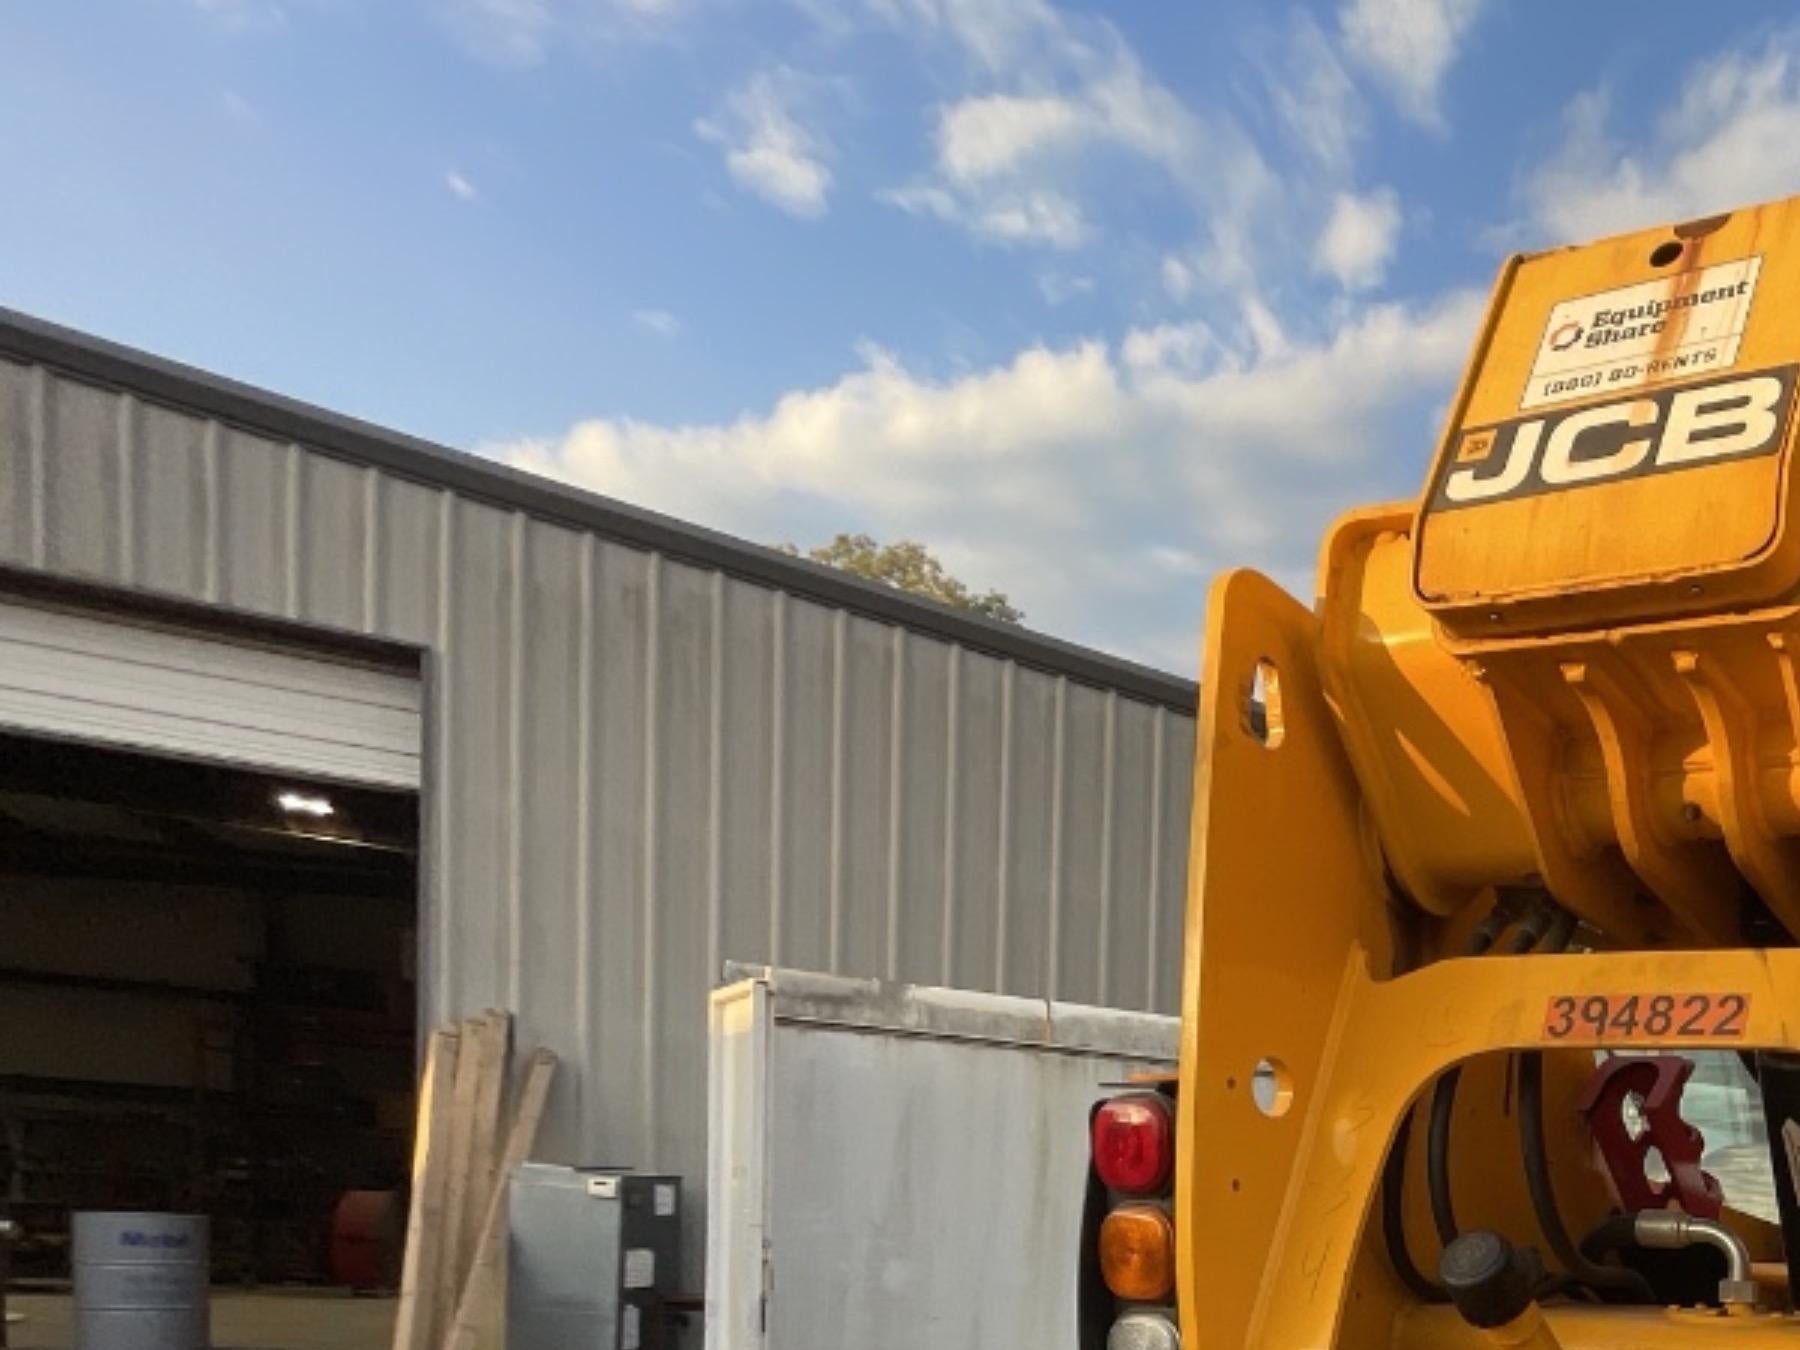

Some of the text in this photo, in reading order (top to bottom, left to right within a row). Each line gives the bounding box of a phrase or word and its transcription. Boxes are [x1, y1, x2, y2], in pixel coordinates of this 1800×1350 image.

[1592, 281, 1748, 329] Equipment
[1584, 320, 1667, 349] Share
[1445, 376, 1783, 501] JCB
[1547, 994, 1745, 1038] 394822
